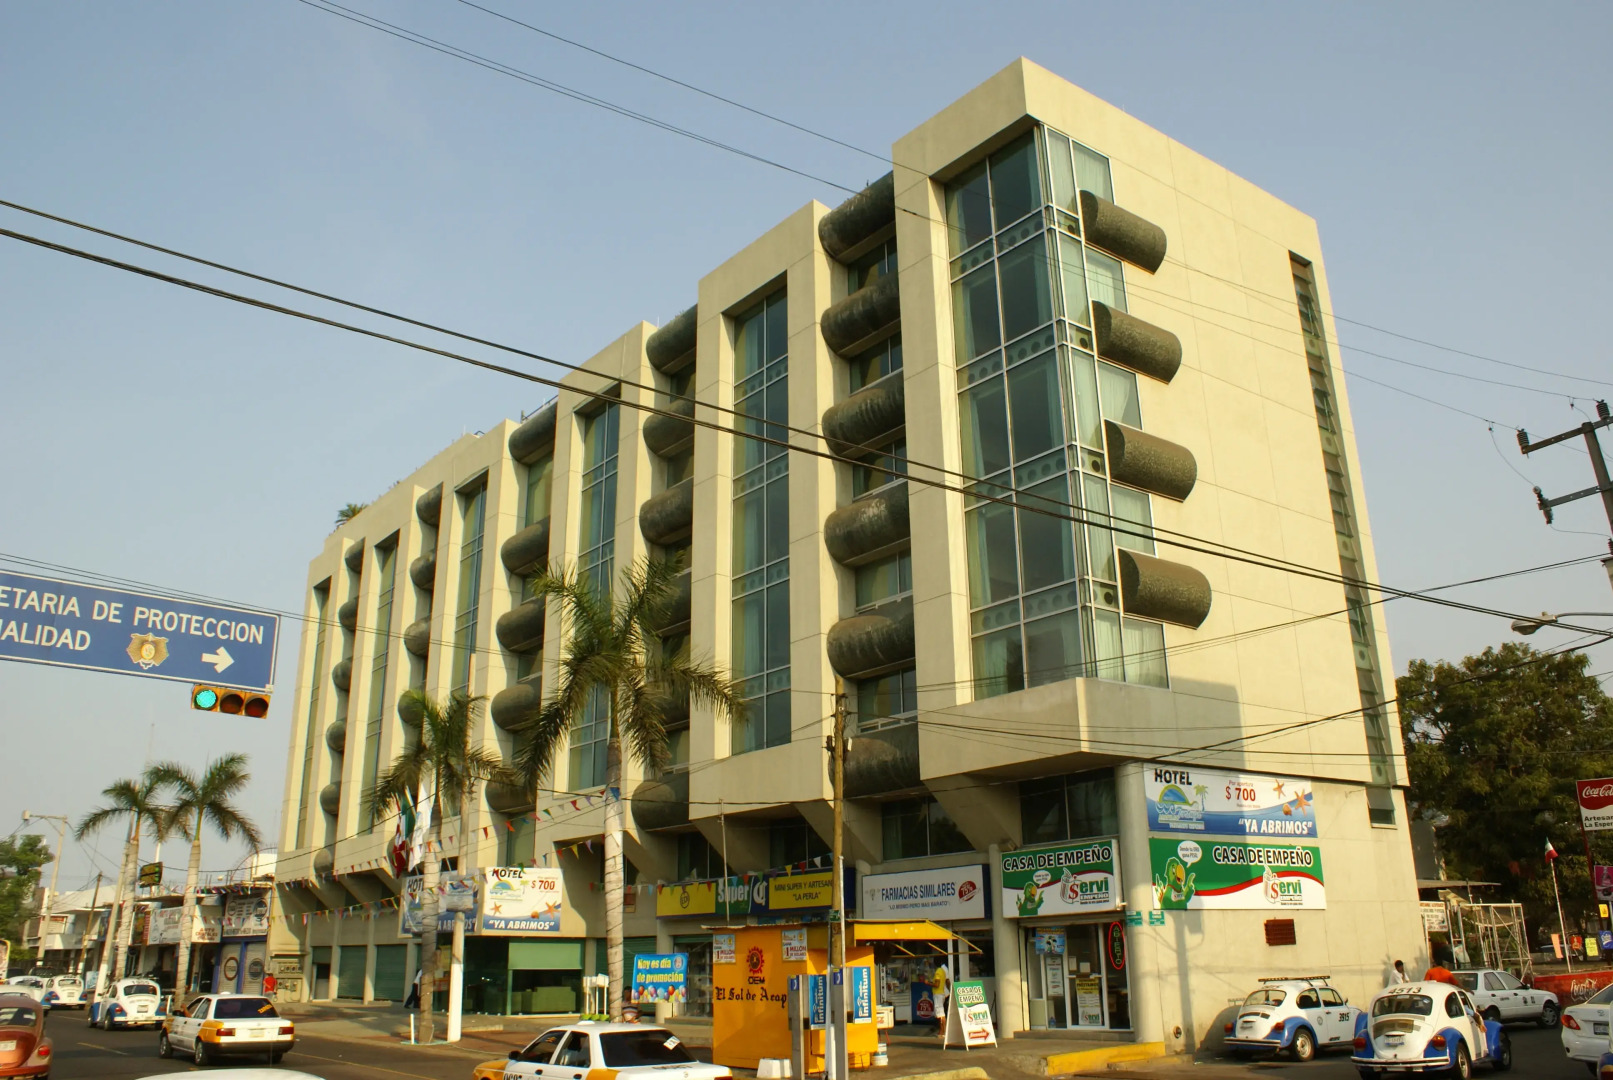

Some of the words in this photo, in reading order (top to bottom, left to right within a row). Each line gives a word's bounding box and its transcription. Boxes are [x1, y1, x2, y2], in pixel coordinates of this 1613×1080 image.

[92, 600, 124, 624] DE
[133, 606, 264, 645] PROTECCION
[1154, 768, 1192, 785] HOTEL
[1225, 786, 1231, 800] $
[1235, 788, 1256, 801] 700
[1003, 856, 1035, 871] CASA
[1037, 853, 1055, 868] DE
[1057, 845, 1111, 866] EMPEÑO
[1213, 846, 1246, 864] CASA
[1247, 849, 1264, 864] DE
[1266, 847, 1313, 866] EMPEÑO
[492, 868, 523, 879] HOTEL
[538, 880, 555, 890] 700
[718, 879, 749, 903] Super
[787, 882, 803, 891] SUPER
[881, 885, 919, 902] FARMACIAS
[920, 882, 956, 899] SIMILARES
[1113, 926, 1122, 965] ABIERTO
[651, 960, 659, 968] es
[636, 972, 645, 983] de
[715, 986, 726, 1001] El
[728, 988, 743, 1001] Sol
[746, 989, 757, 1001] de
[860, 968, 869, 1018] Infinitum
[973, 986, 982, 994] DE
[1388, 986, 1422, 994] 4513
[1338, 1012, 1350, 1022] 3915
